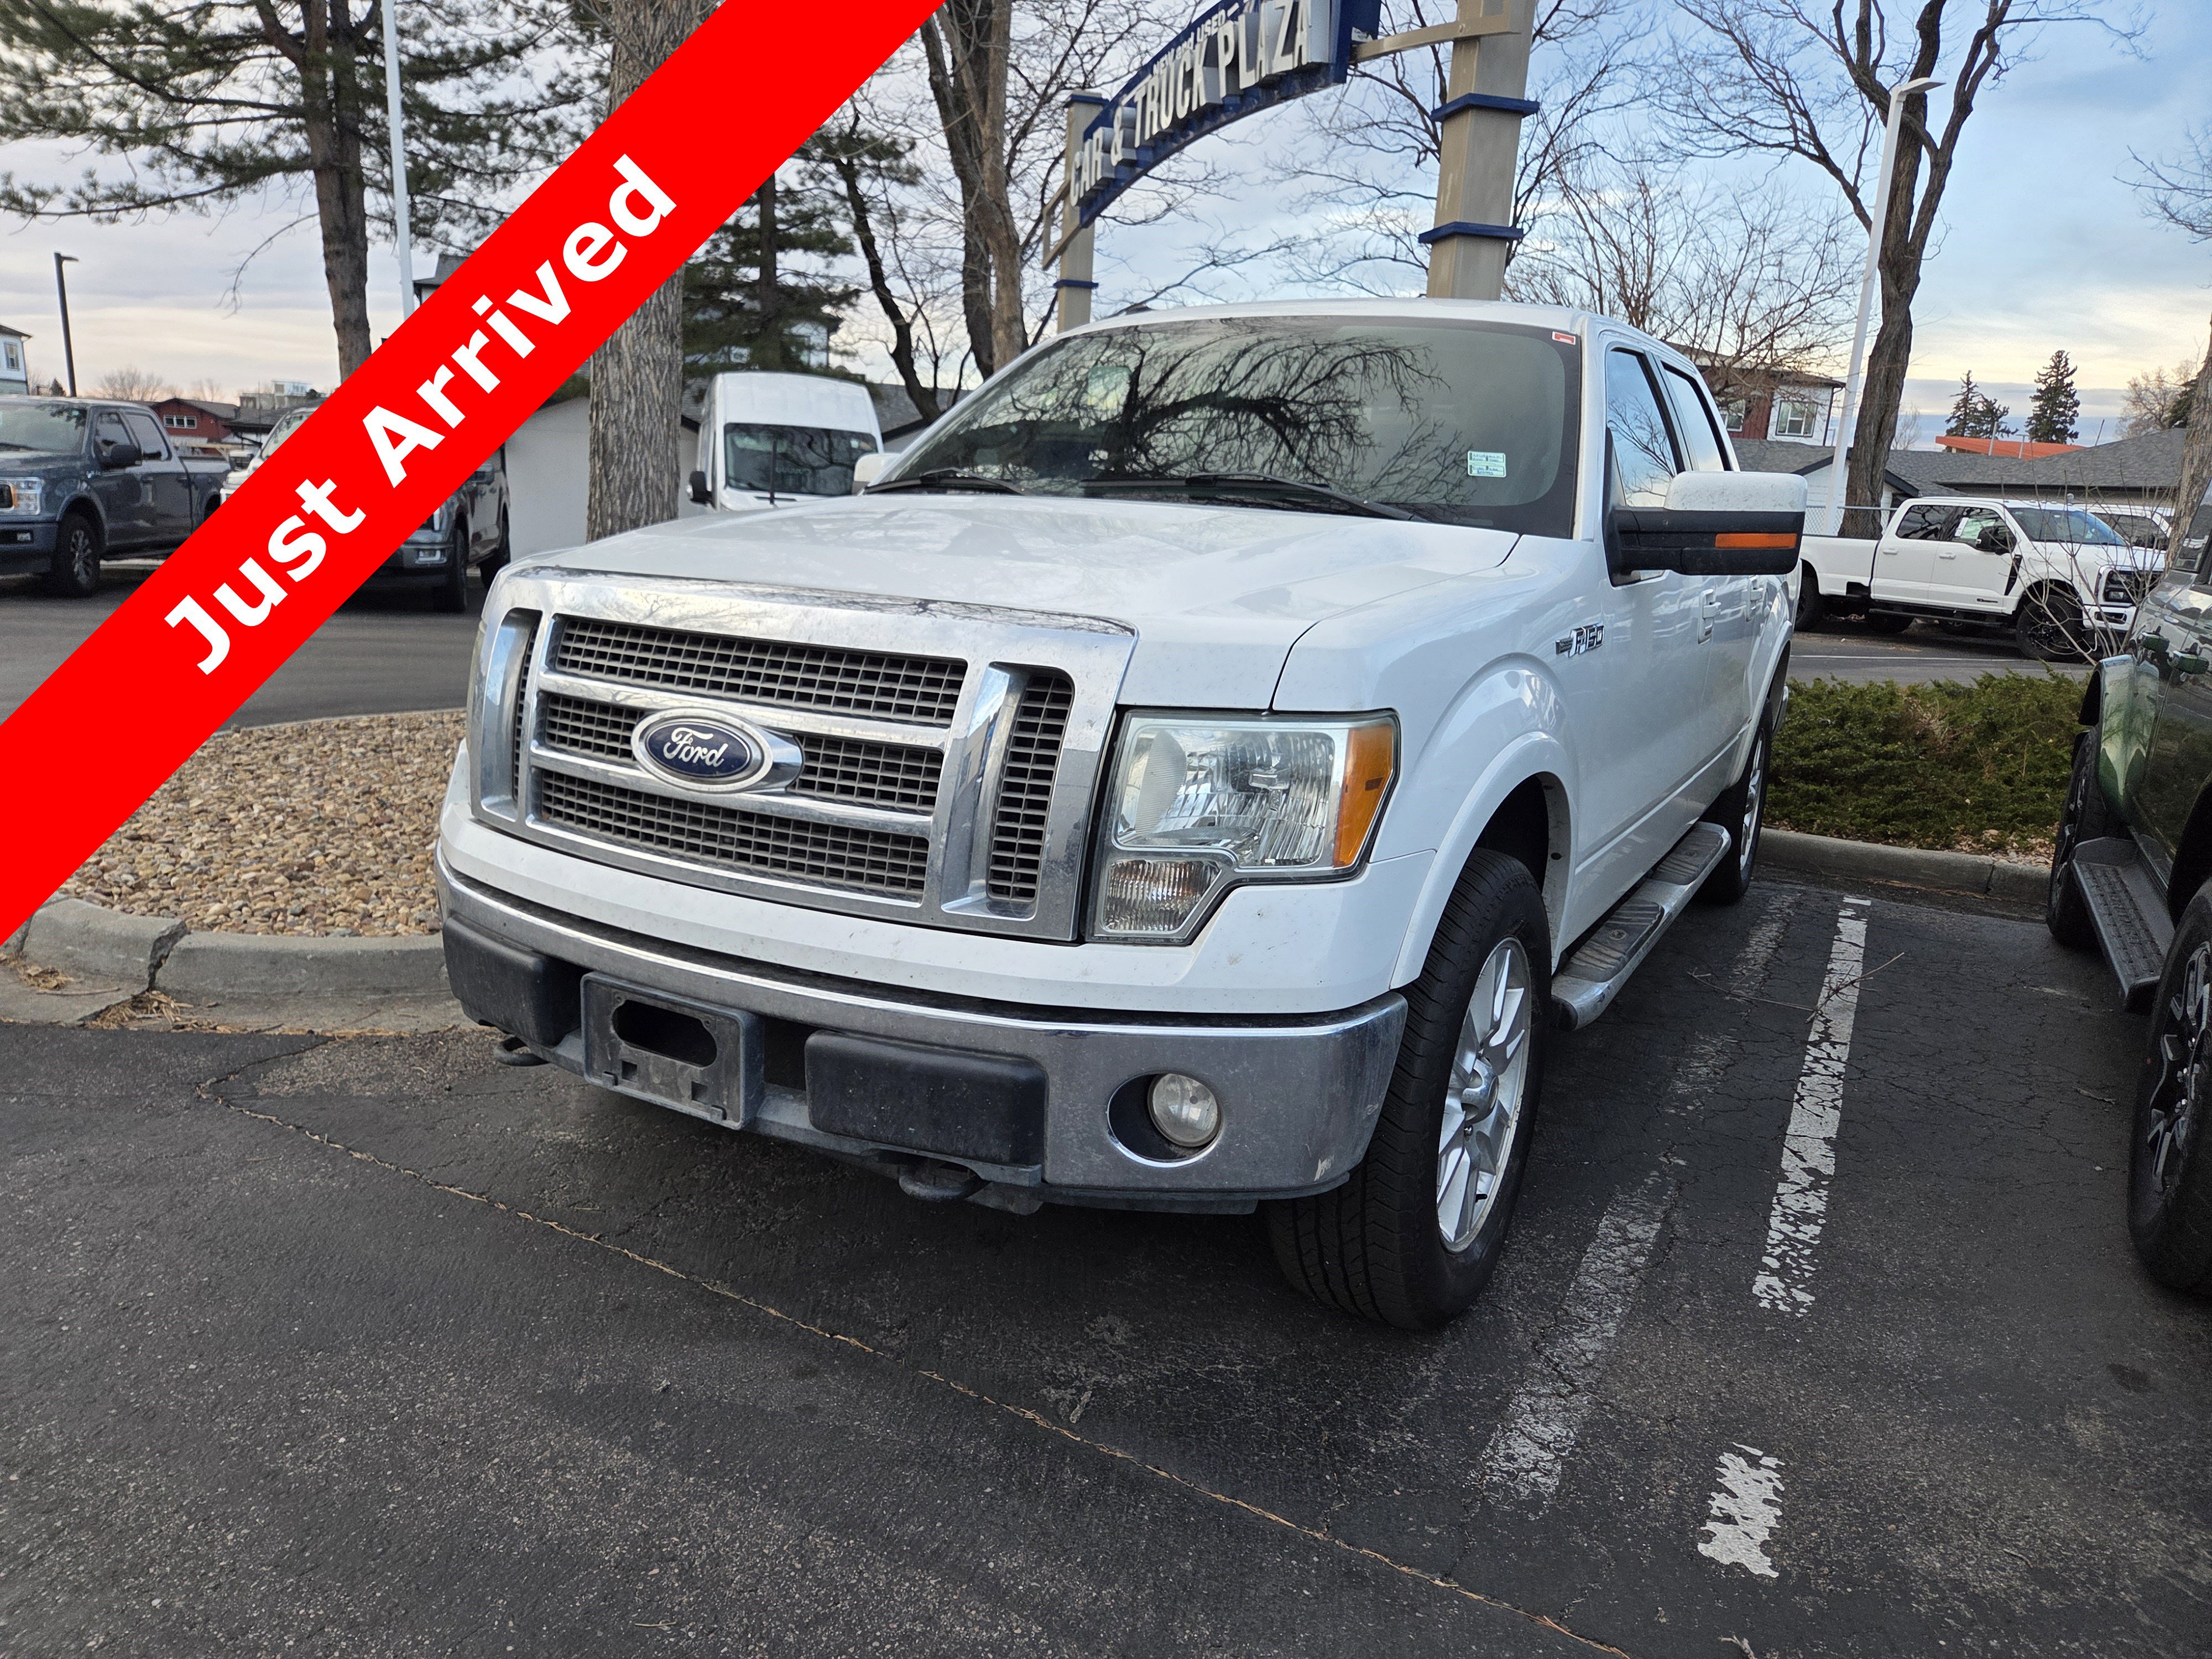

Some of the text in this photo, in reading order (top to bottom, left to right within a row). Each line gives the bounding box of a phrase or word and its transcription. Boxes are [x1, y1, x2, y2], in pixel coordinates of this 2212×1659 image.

[1196, 9, 1226, 43] USED
[1070, 0, 1308, 207] CAR & TRUCK PLAZA
[664, 727, 728, 768] Ford
